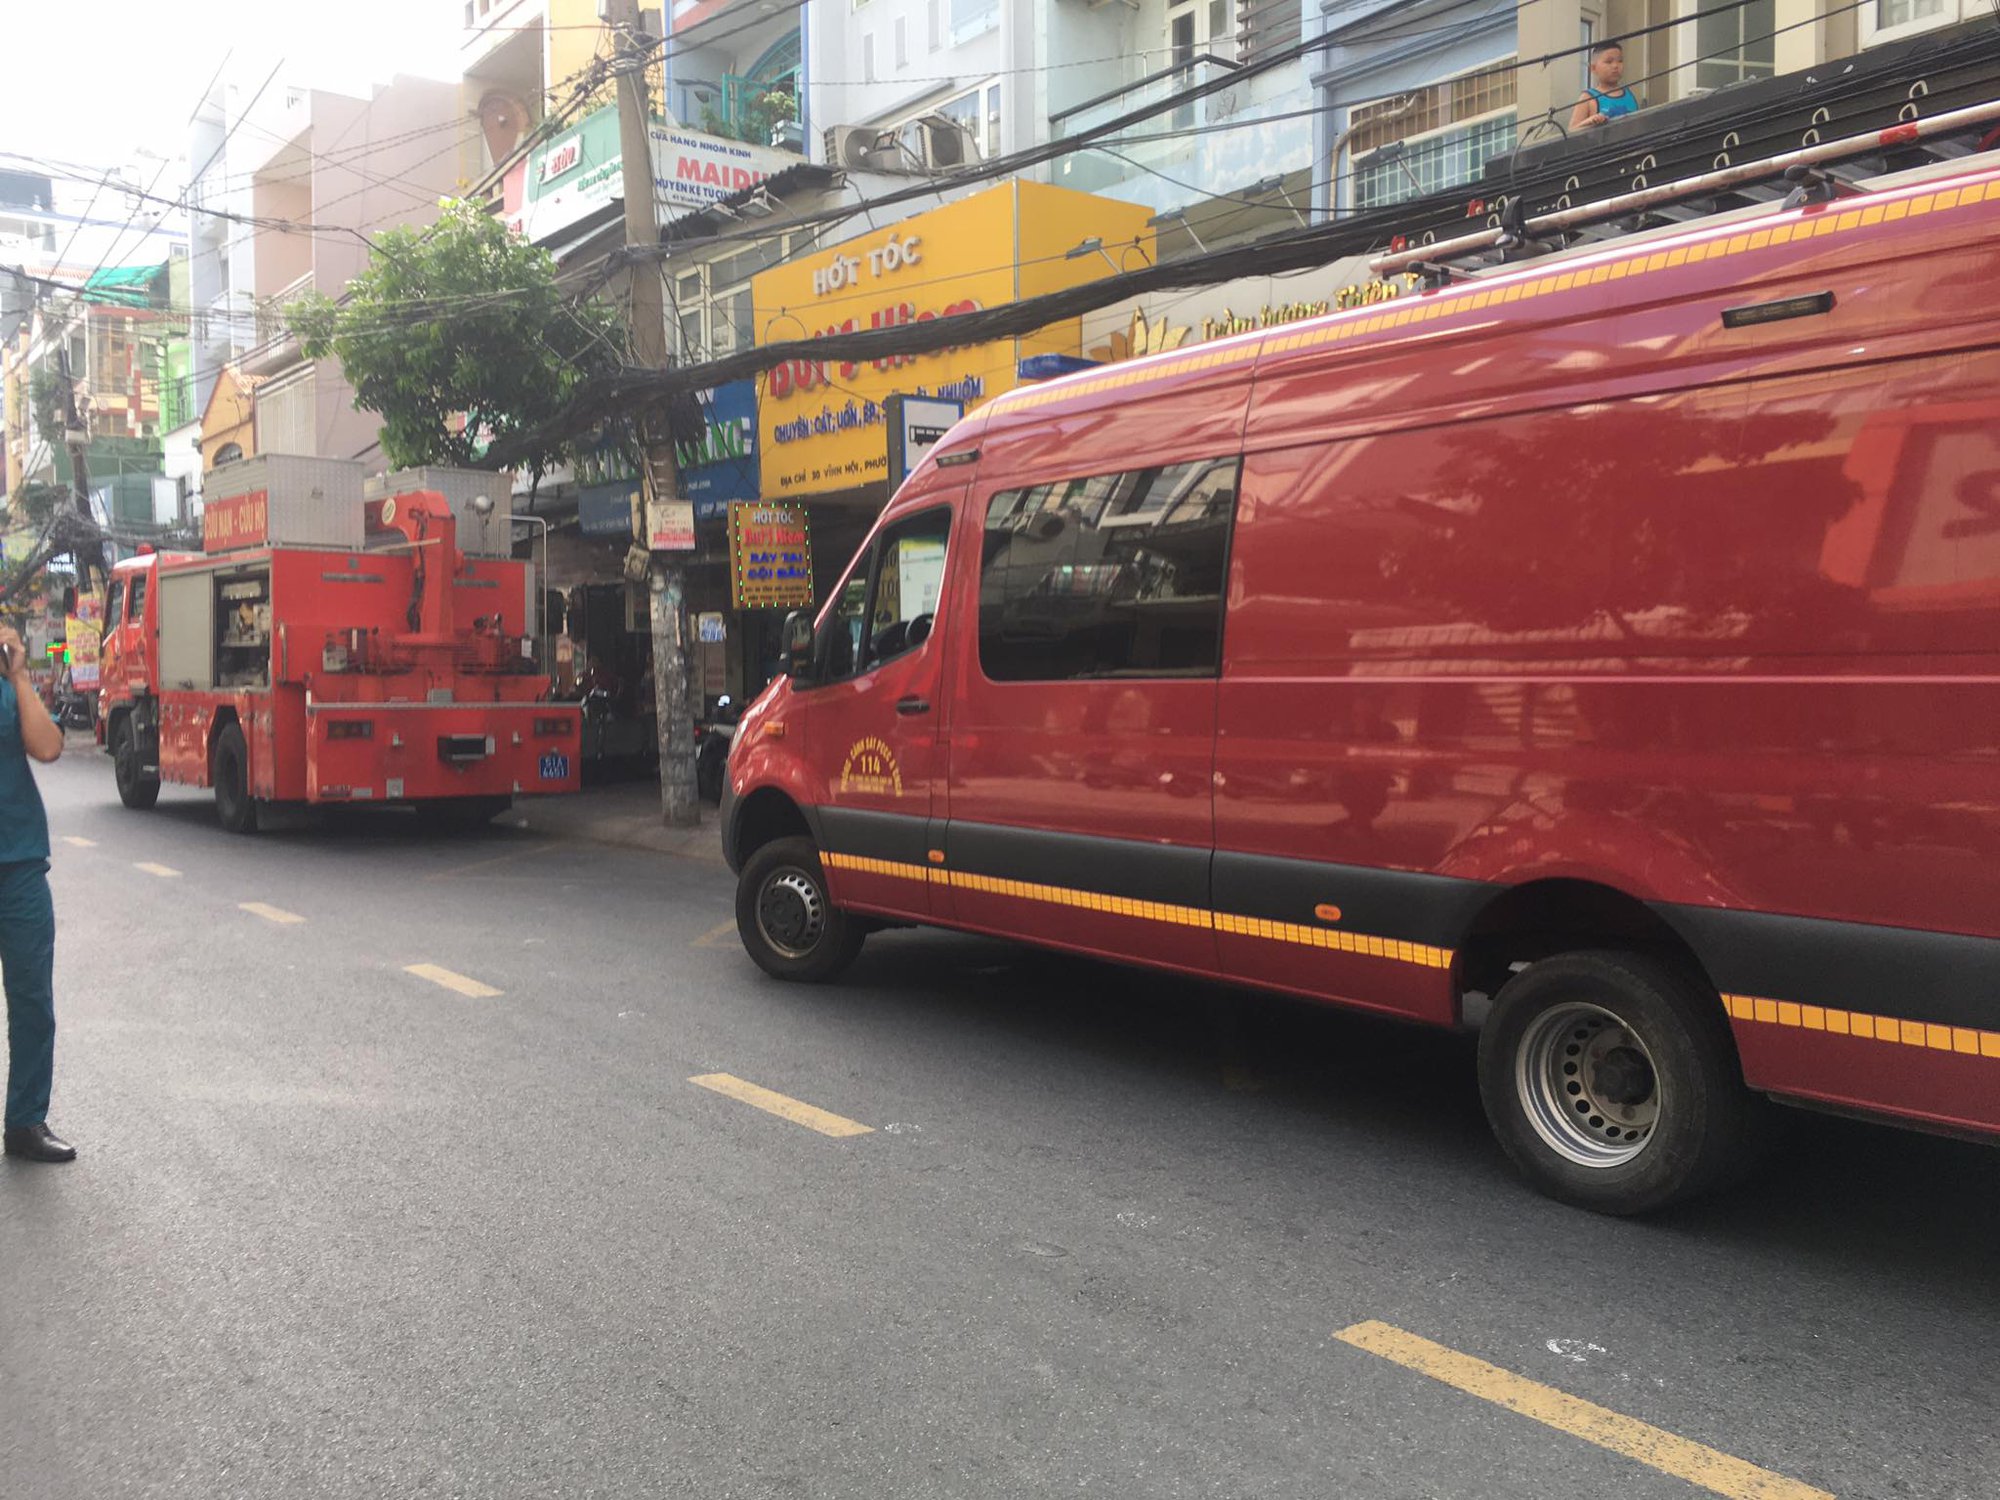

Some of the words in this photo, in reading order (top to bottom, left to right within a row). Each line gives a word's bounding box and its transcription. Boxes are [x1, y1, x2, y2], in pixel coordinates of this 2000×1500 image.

[813, 253, 860, 296] HỚT
[867, 234, 922, 277] TÓC
[861, 755, 880, 774] 114
